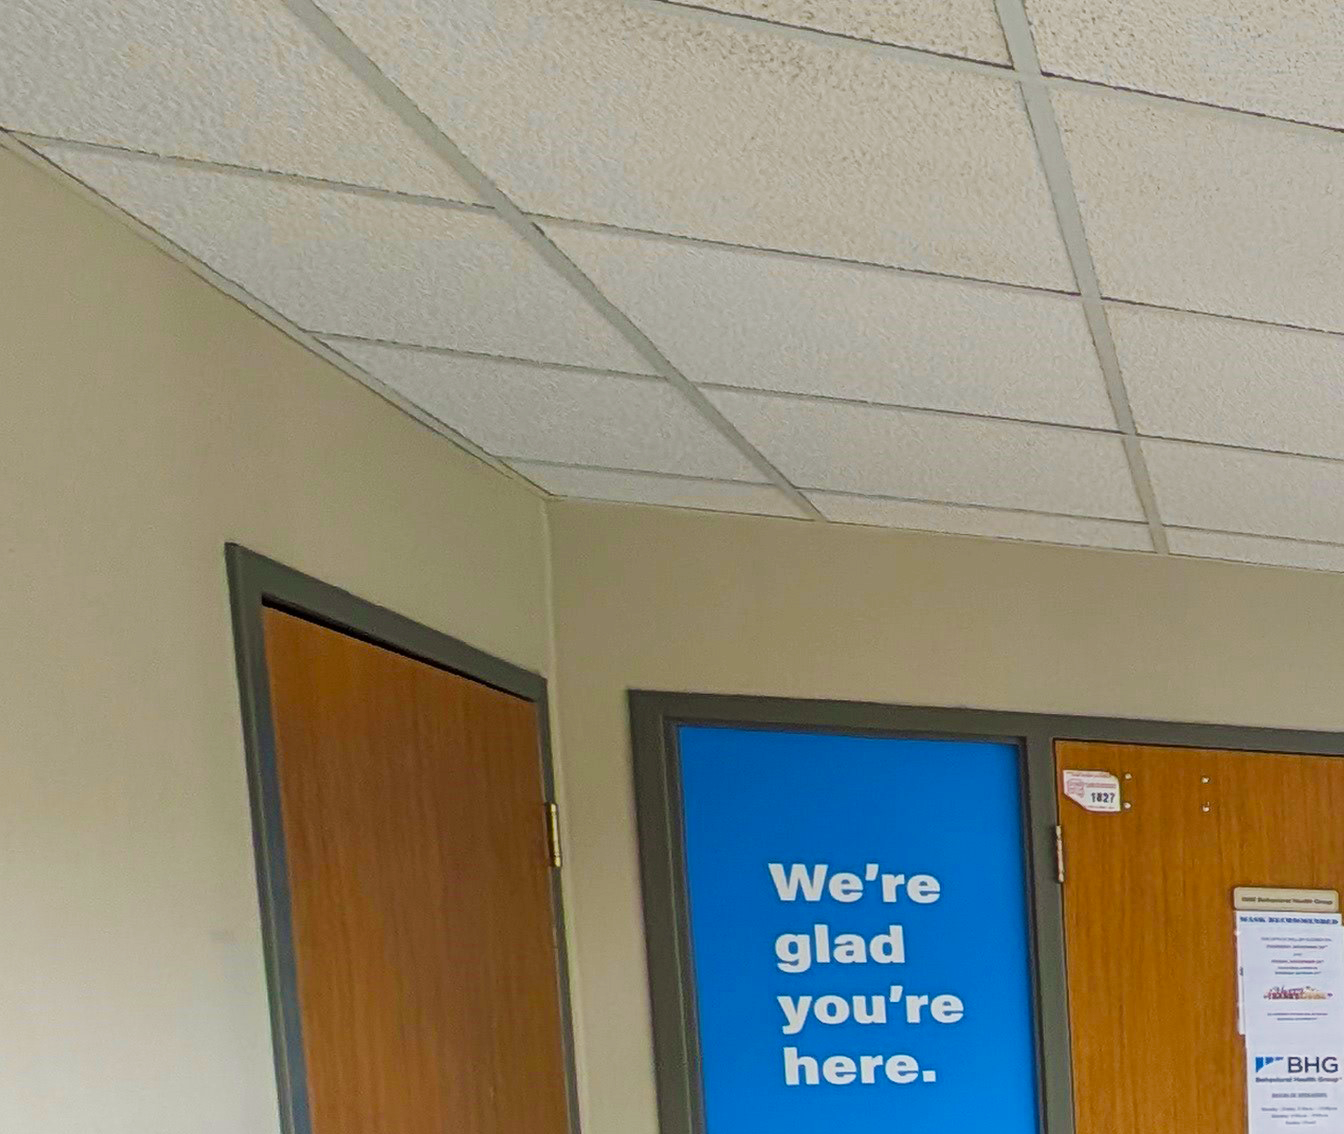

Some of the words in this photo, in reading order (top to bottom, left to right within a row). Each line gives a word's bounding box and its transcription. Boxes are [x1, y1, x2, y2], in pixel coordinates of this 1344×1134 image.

[768, 863, 941, 904] We're
[775, 925, 905, 973] glad
[777, 986, 964, 1034] you're
[783, 1046, 936, 1086] here.
[1288, 1056, 1339, 1073] BHG
